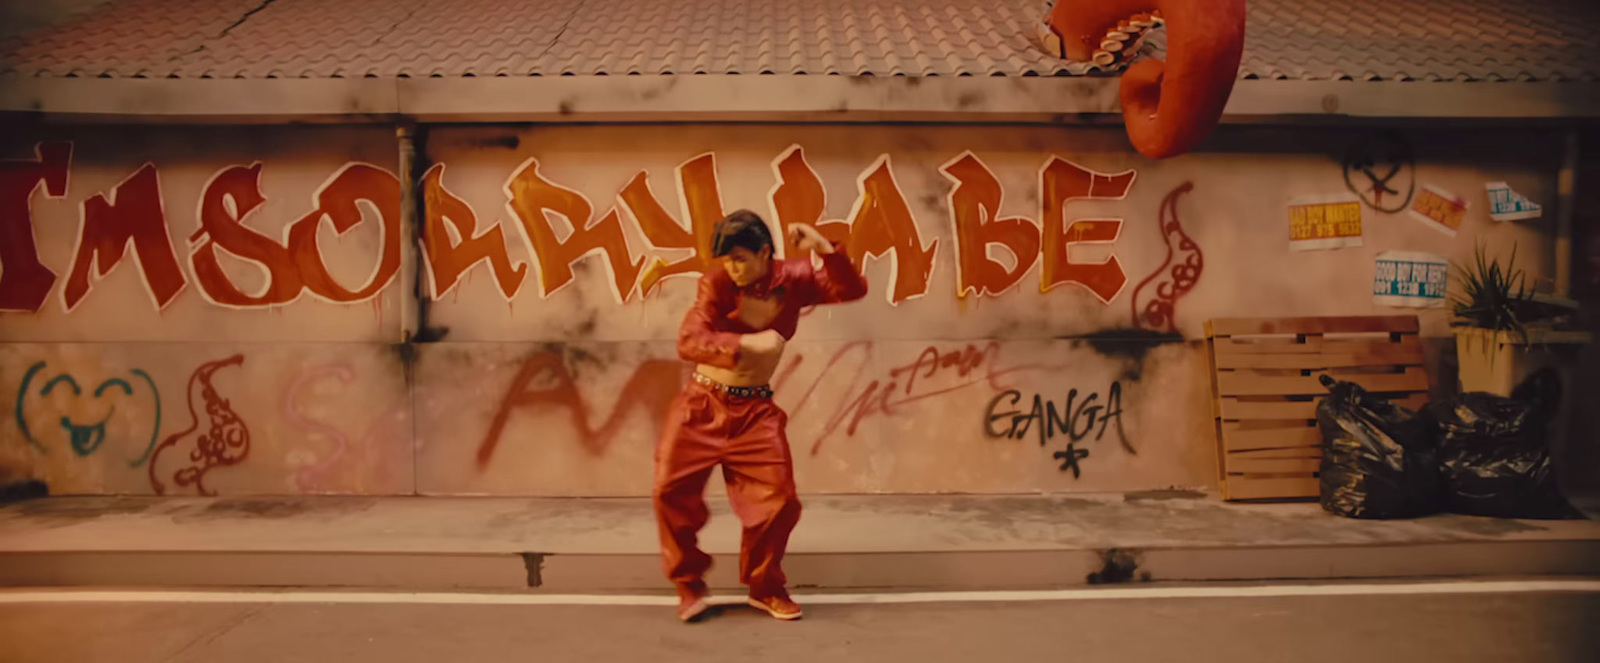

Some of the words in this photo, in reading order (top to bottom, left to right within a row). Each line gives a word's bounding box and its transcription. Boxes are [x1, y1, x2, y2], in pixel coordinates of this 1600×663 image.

[1375, 261, 1396, 282] GOOD
[1397, 262, 1412, 283] BOY
[1412, 263, 1427, 283] FOR
[984, 381, 1137, 455] GANGA
